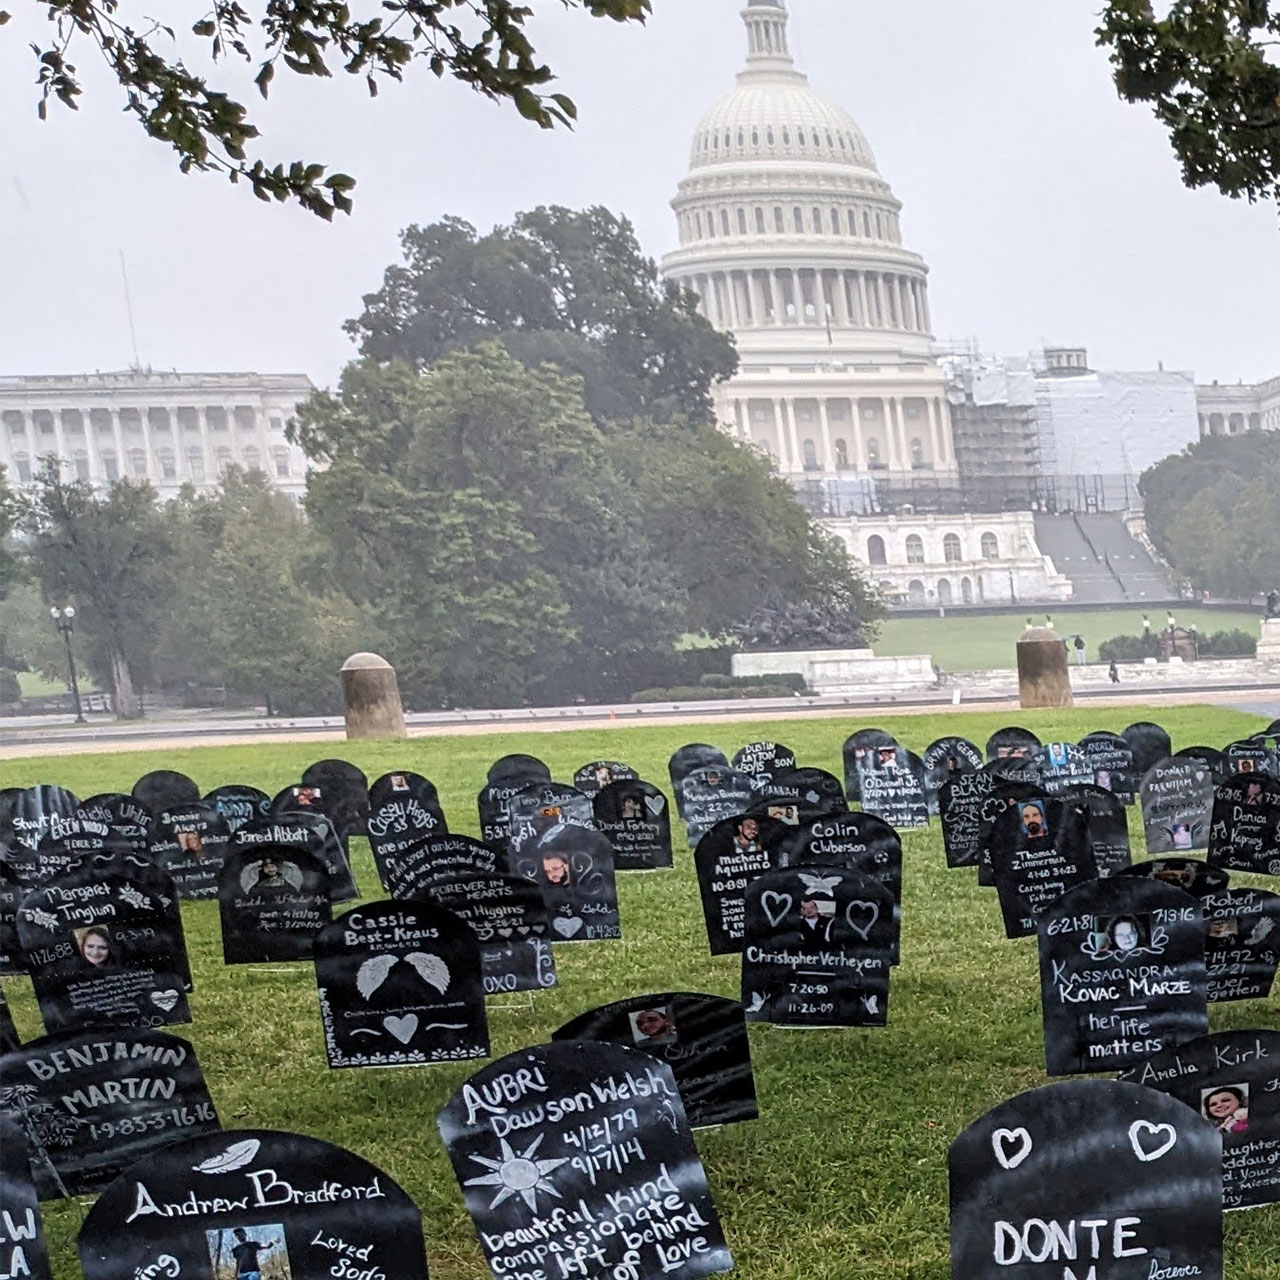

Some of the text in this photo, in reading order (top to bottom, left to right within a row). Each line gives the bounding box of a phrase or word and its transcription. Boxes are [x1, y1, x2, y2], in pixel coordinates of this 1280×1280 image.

[774, 757, 795, 768] SON
[368, 803, 405, 836] Casey
[811, 823, 859, 838] Colin
[236, 826, 309, 844] Jared Abbott
[1011, 857, 1066, 870] Zimmerman
[1016, 849, 1057, 860] Thomas
[45, 882, 111, 904] Margaret
[430, 880, 487, 896] FOREVER
[473, 904, 525, 919] Higgins
[1200, 891, 1257, 909] Robert
[58, 903, 116, 923] Tinglum
[348, 912, 416, 930] Cassie
[344, 927, 440, 946] Best-Kraus
[746, 947, 819, 969] Christopher
[1088, 1012, 1151, 1037] her life
[1089, 1038, 1163, 1059] matters
[26, 1040, 187, 1082] BENJAMIN
[1140, 1039, 1271, 1086] Amelia Kirk
[61, 1076, 177, 1116] MARTIN
[463, 1065, 549, 1126] AUBRI
[489, 1067, 677, 1139] Dawson Welsh
[563, 1107, 639, 1151] 4/12/79
[126, 1168, 386, 1224] Andrew Bradford
[311, 1229, 374, 1262] Loved
[490, 1194, 685, 1275] compassionate
[559, 1244, 613, 1280] left
[621, 1204, 710, 1251] behind
[993, 1216, 1148, 1266] DONTE
[654, 1234, 712, 1274] Love
